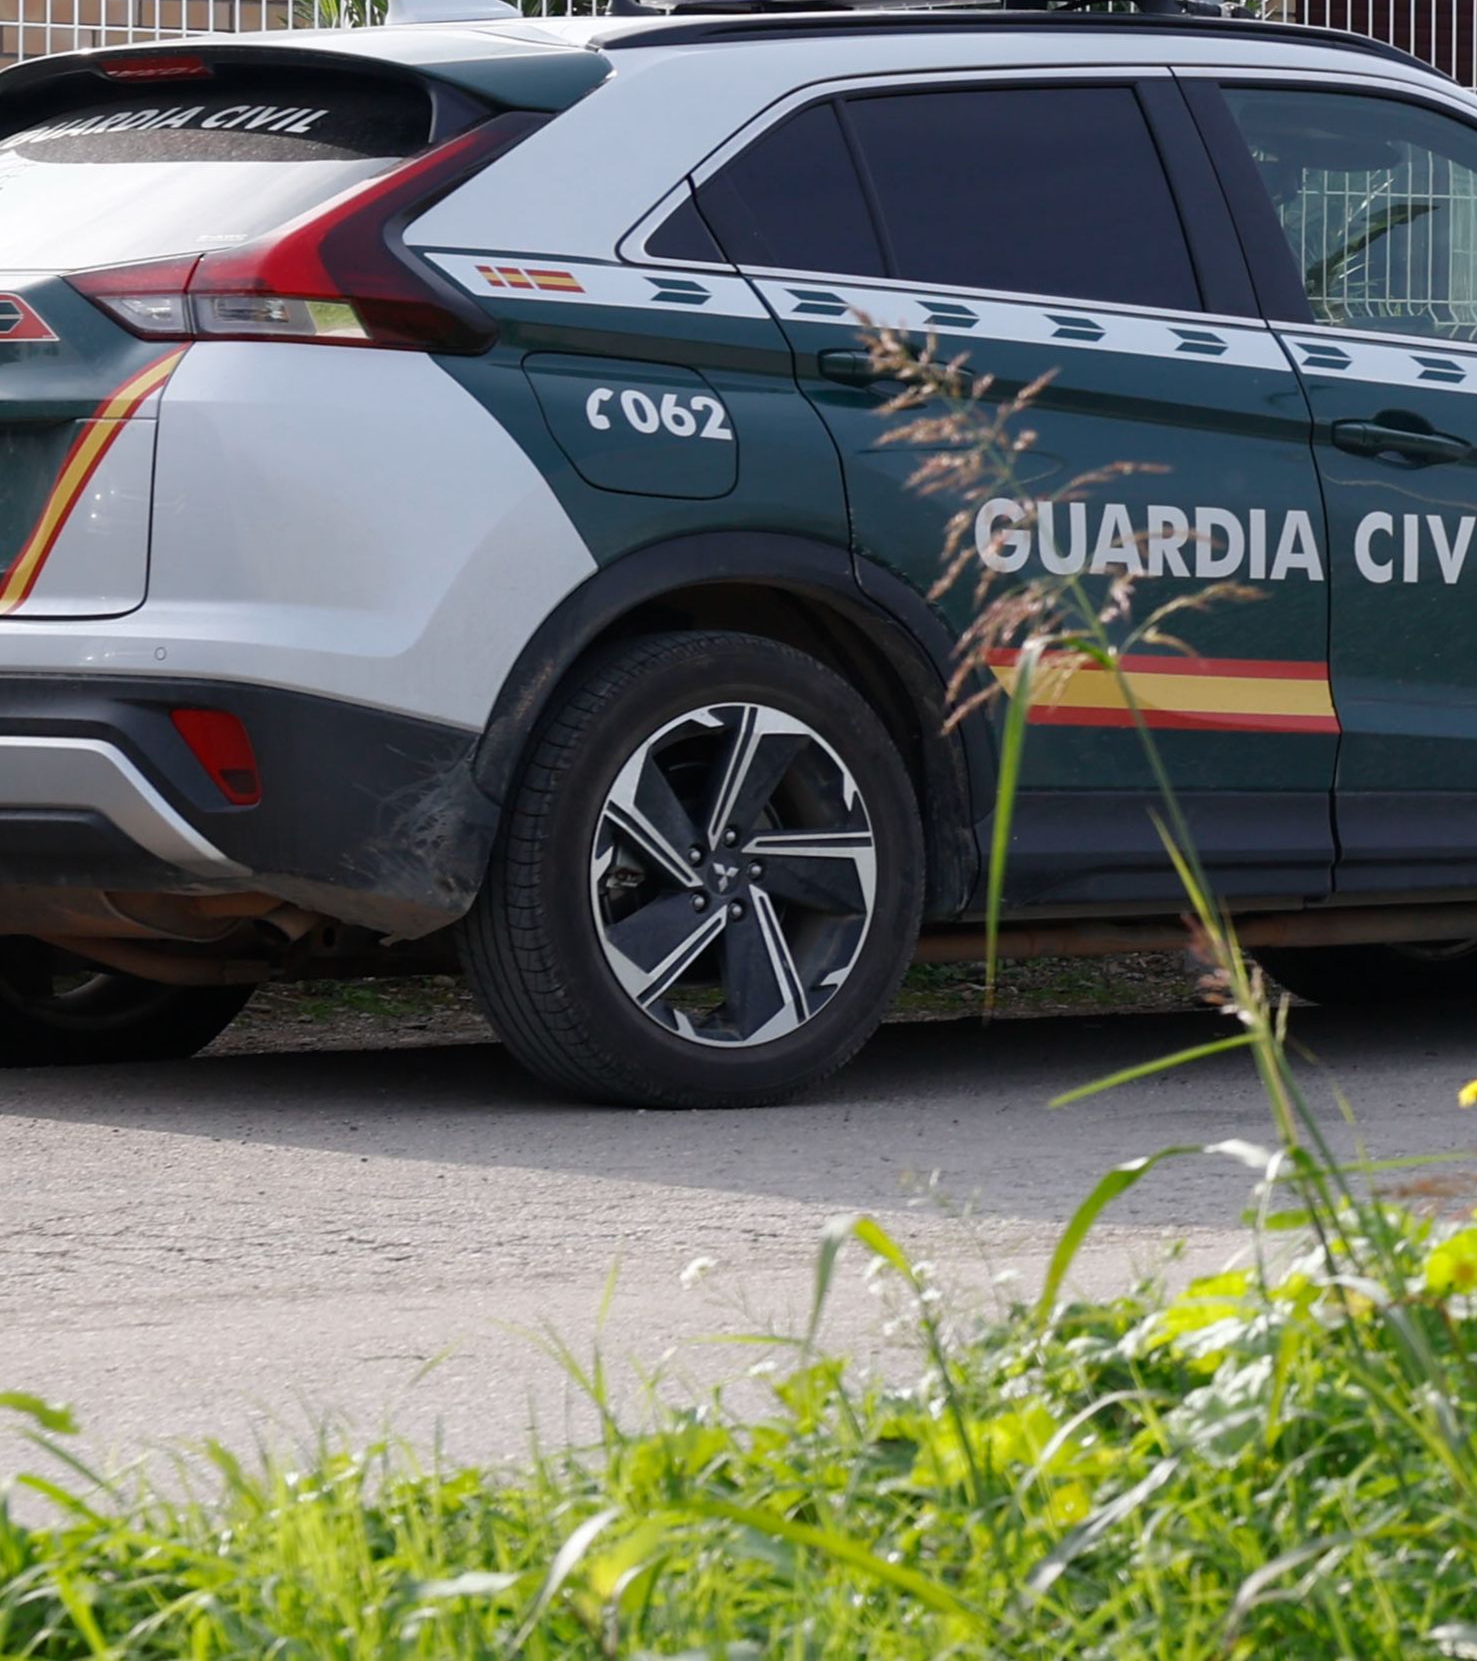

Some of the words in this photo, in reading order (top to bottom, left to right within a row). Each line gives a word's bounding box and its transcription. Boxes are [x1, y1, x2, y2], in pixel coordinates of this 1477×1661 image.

[201, 105, 328, 133] CIVIL
[620, 389, 733, 440] 062
[974, 498, 1324, 581] GUARDIA
